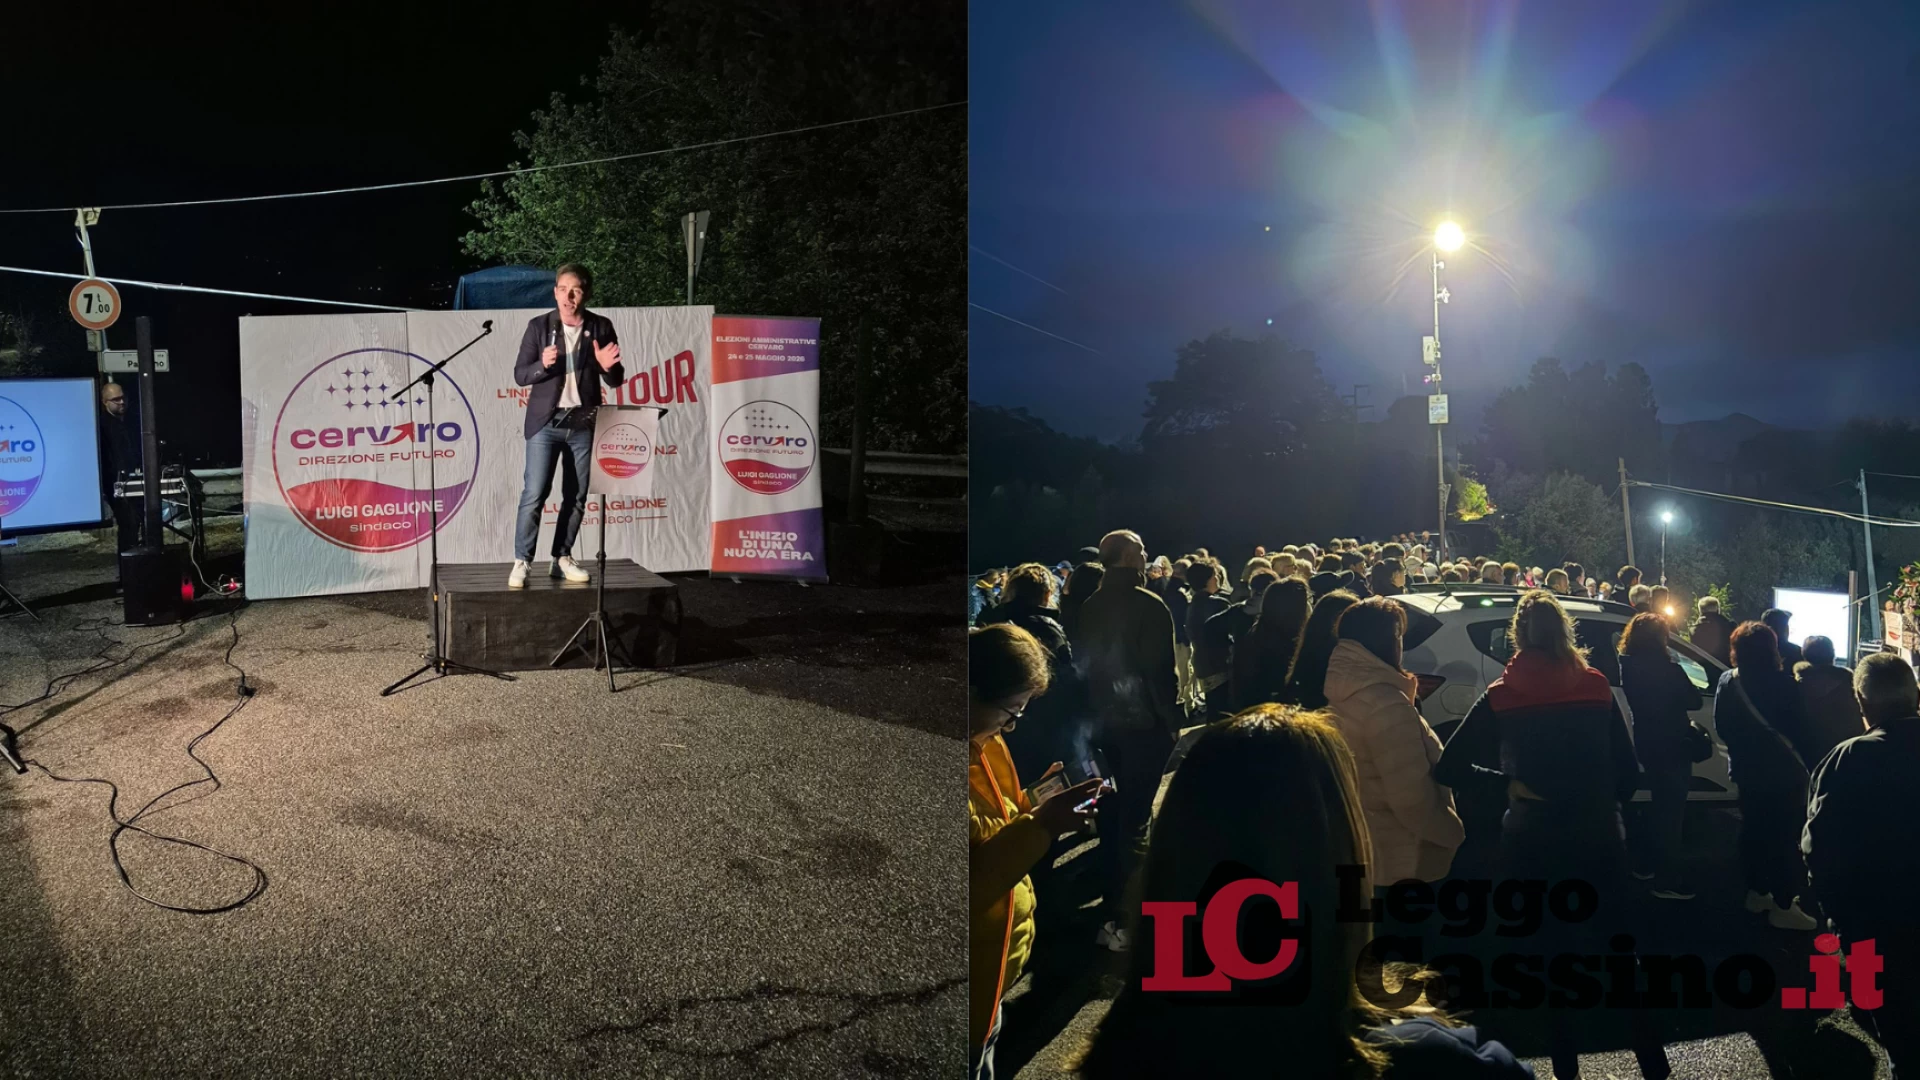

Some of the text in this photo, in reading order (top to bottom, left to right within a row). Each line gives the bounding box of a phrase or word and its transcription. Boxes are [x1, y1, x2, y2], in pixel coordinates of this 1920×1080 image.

[751, 337, 816, 345] AMMINISTRATIVE
[748, 343, 784, 351] CERVARO
[755, 354, 785, 362] MAGGIO
[615, 350, 698, 407] TOUR
[0, 456, 33, 464] UTURO
[298, 449, 456, 466] DIREZIONE FUTURO
[758, 472, 798, 480] GAGLIONE
[315, 500, 444, 520] LUIGI GAGLIONE
[349, 521, 412, 533] sindaco
[738, 530, 798, 541] L'INIZIO
[742, 540, 795, 550] DI UNA
[723, 547, 814, 561] NUOVA ERA
